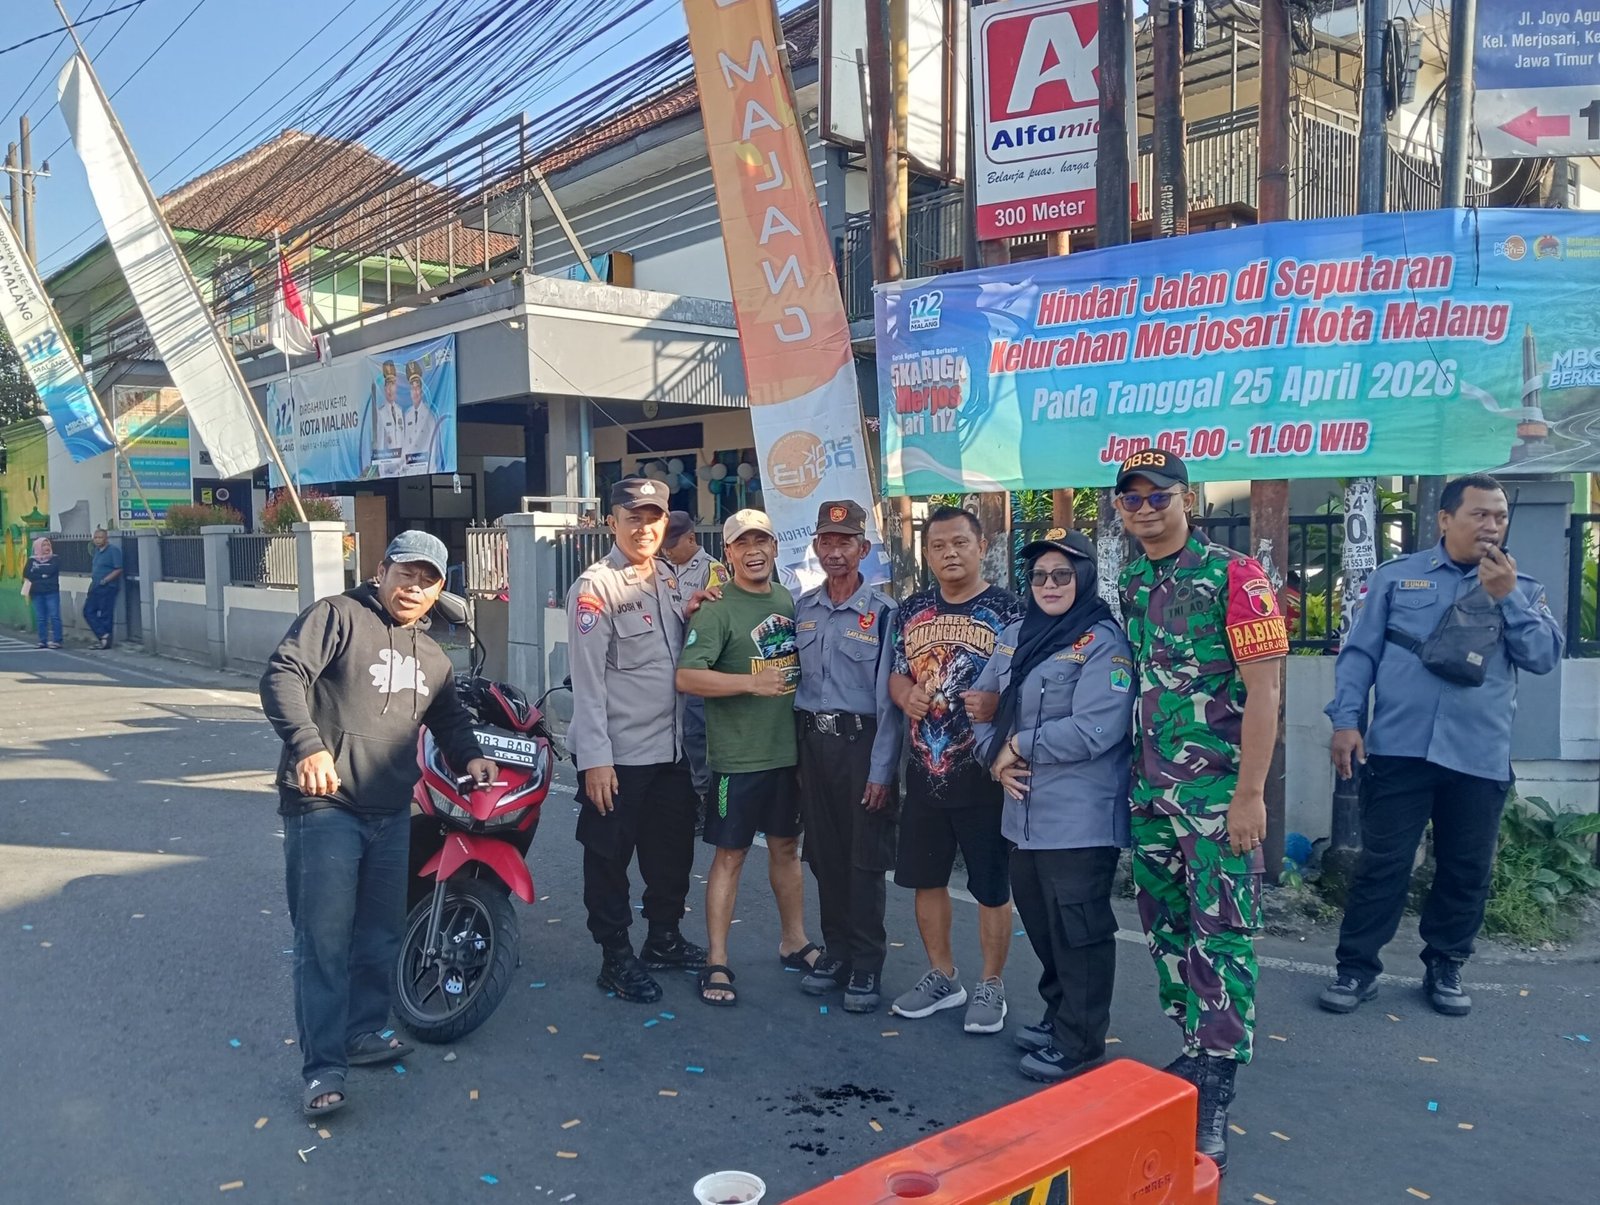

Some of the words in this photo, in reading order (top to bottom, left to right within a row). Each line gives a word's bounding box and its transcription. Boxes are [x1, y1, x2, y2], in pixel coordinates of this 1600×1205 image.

[1518, 11, 1534, 26] Jl.
[1539, 11, 1570, 27] Joyo
[1482, 34, 1507, 48] Kel.
[1512, 31, 1581, 49] Merjosari,
[1515, 54, 1550, 69] Jawa
[1554, 52, 1594, 67] Timur
[987, 169, 1025, 184] Belanja
[1027, 166, 1056, 181] puas,
[1060, 159, 1090, 175] harga
[994, 205, 1027, 227] 300
[1032, 198, 1086, 222] Meter
[1036, 277, 1139, 327] Hindari
[1142, 271, 1229, 314] Jalan
[1234, 260, 1269, 302] di
[1273, 253, 1454, 301] Seputaran
[910, 290, 942, 319] 112
[910, 321, 938, 331] MALANG
[988, 330, 1128, 375] Kelurahan
[1133, 306, 1291, 359] Merjosari
[1295, 304, 1374, 345] Kota
[1380, 299, 1510, 341] Malang
[896, 384, 962, 416] Merjos
[1031, 383, 1099, 421] Pada
[1106, 370, 1226, 415] Tanggal
[1230, 366, 1275, 406] 25
[1279, 361, 1363, 408] April
[1367, 358, 1458, 399] 2026
[300, 418, 320, 437] KOTA
[321, 411, 359, 434] MALANG
[896, 414, 925, 438] Lari
[930, 410, 957, 434] 112
[1100, 435, 1150, 463] Jam
[1157, 428, 1226, 459] 05.00
[1249, 424, 1313, 455] 11.00
[1319, 421, 1370, 453] WIB
[1122, 452, 1166, 472] 0833
[617, 602, 635, 614] JOSH
